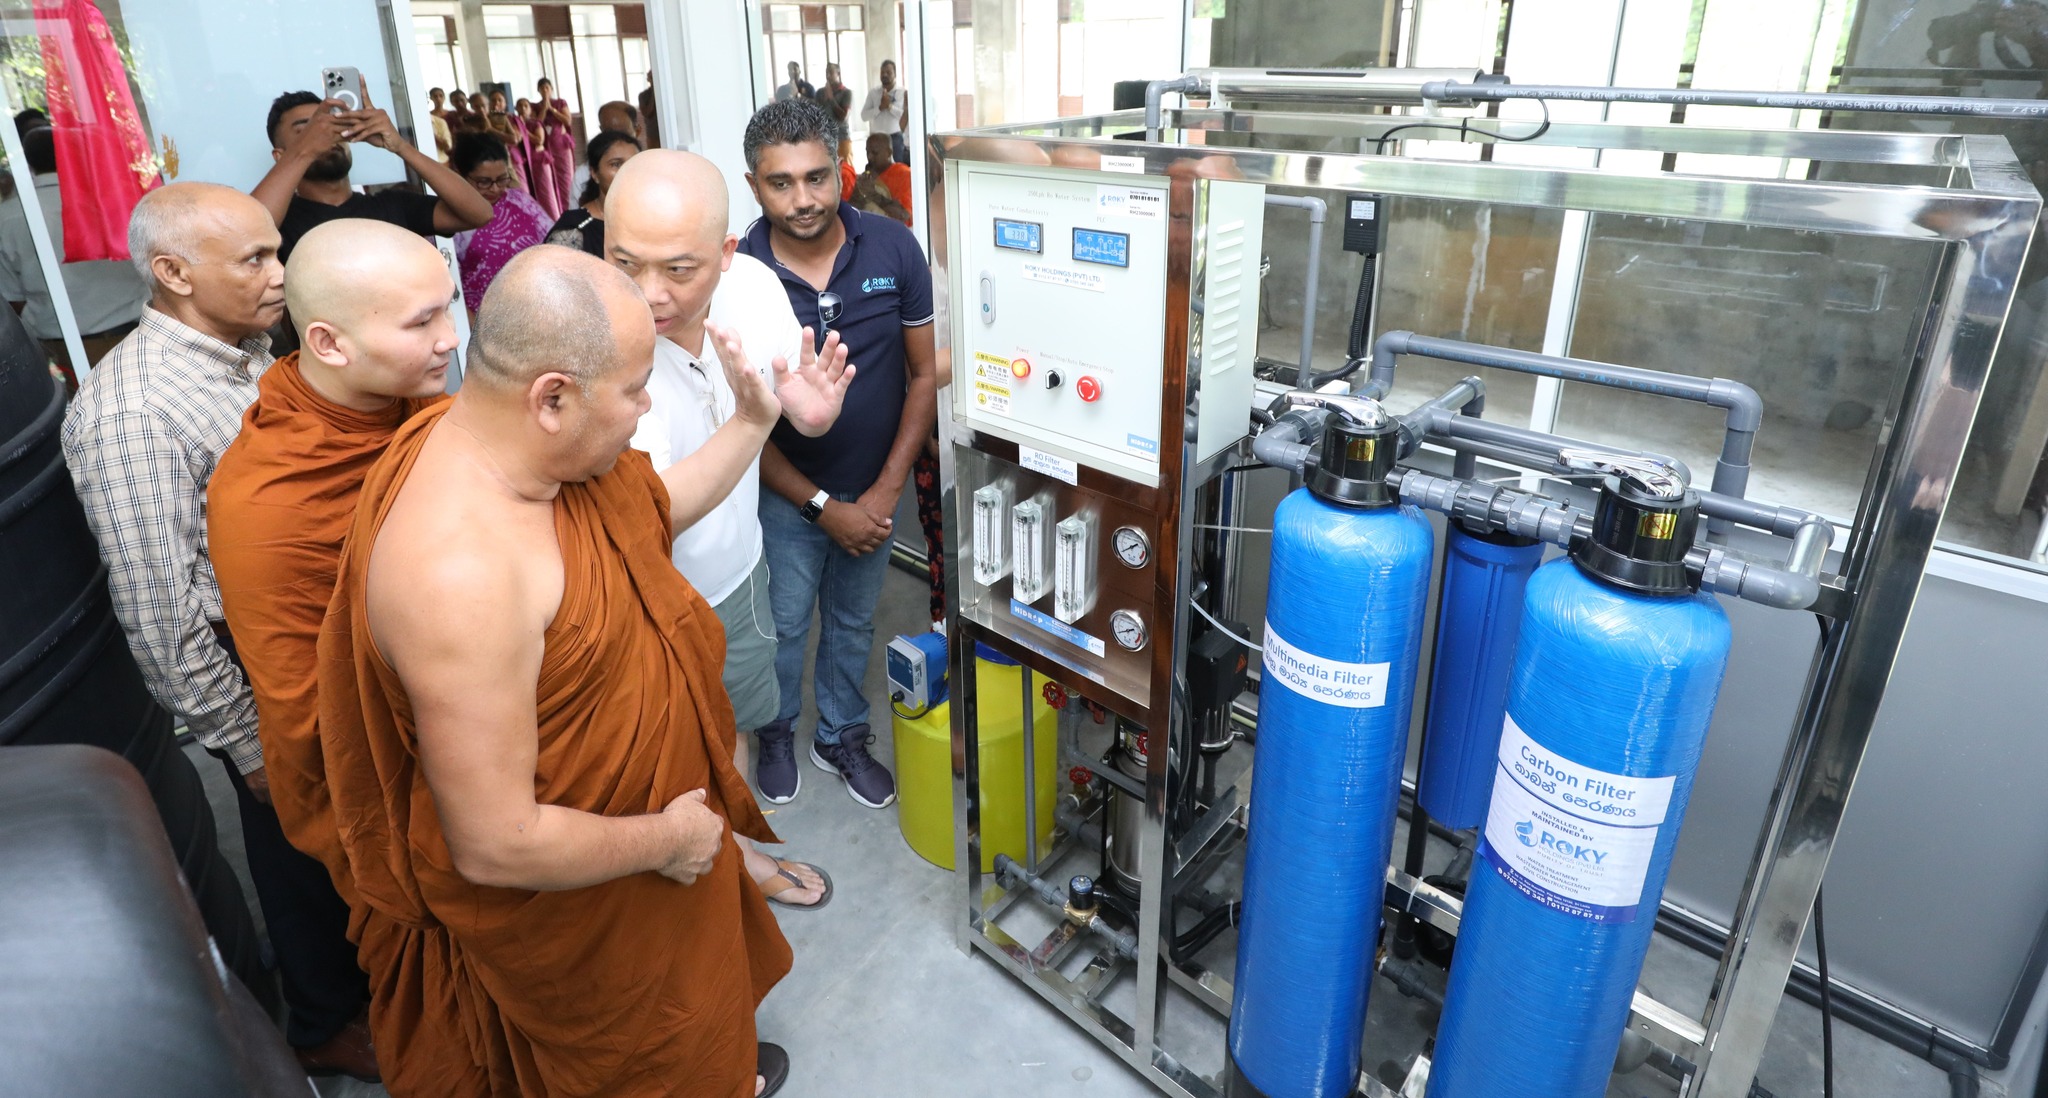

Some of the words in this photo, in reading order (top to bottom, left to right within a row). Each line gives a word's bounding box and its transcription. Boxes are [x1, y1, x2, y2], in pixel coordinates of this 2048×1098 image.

[1072, 194, 1090, 202] System
[872, 277, 895, 286] ROKY
[1042, 267, 1071, 277] HOLDINGS
[1034, 452, 1043, 460] RO
[1044, 455, 1060, 466] Filter
[1267, 634, 1329, 680] Multimedia
[1334, 670, 1373, 685] Filter
[1313, 684, 1371, 700] පෙරණය
[1521, 745, 1579, 788] Carbon
[1584, 778, 1636, 801] Filter
[1563, 792, 1636, 818] පෙරණය
[1531, 810, 1580, 838] MAINTAINED
[1582, 834, 1594, 842] BY
[1541, 810, 1578, 830] INSTALLED
[1537, 850, 1563, 866] PURITY
[1538, 844, 1575, 865] HOLDINGS
[1540, 830, 1609, 865] ROKY
[1515, 854, 1549, 876] WASTEWATER
[1549, 873, 1591, 891] MANAGEMENT
[1522, 865, 1535, 876] CIVIL
[1536, 873, 1579, 894] CONSTRUCTION
[1527, 856, 1545, 869] WATER
[1546, 865, 1579, 882] TREATMENT
[1551, 902, 1570, 913] 0112
